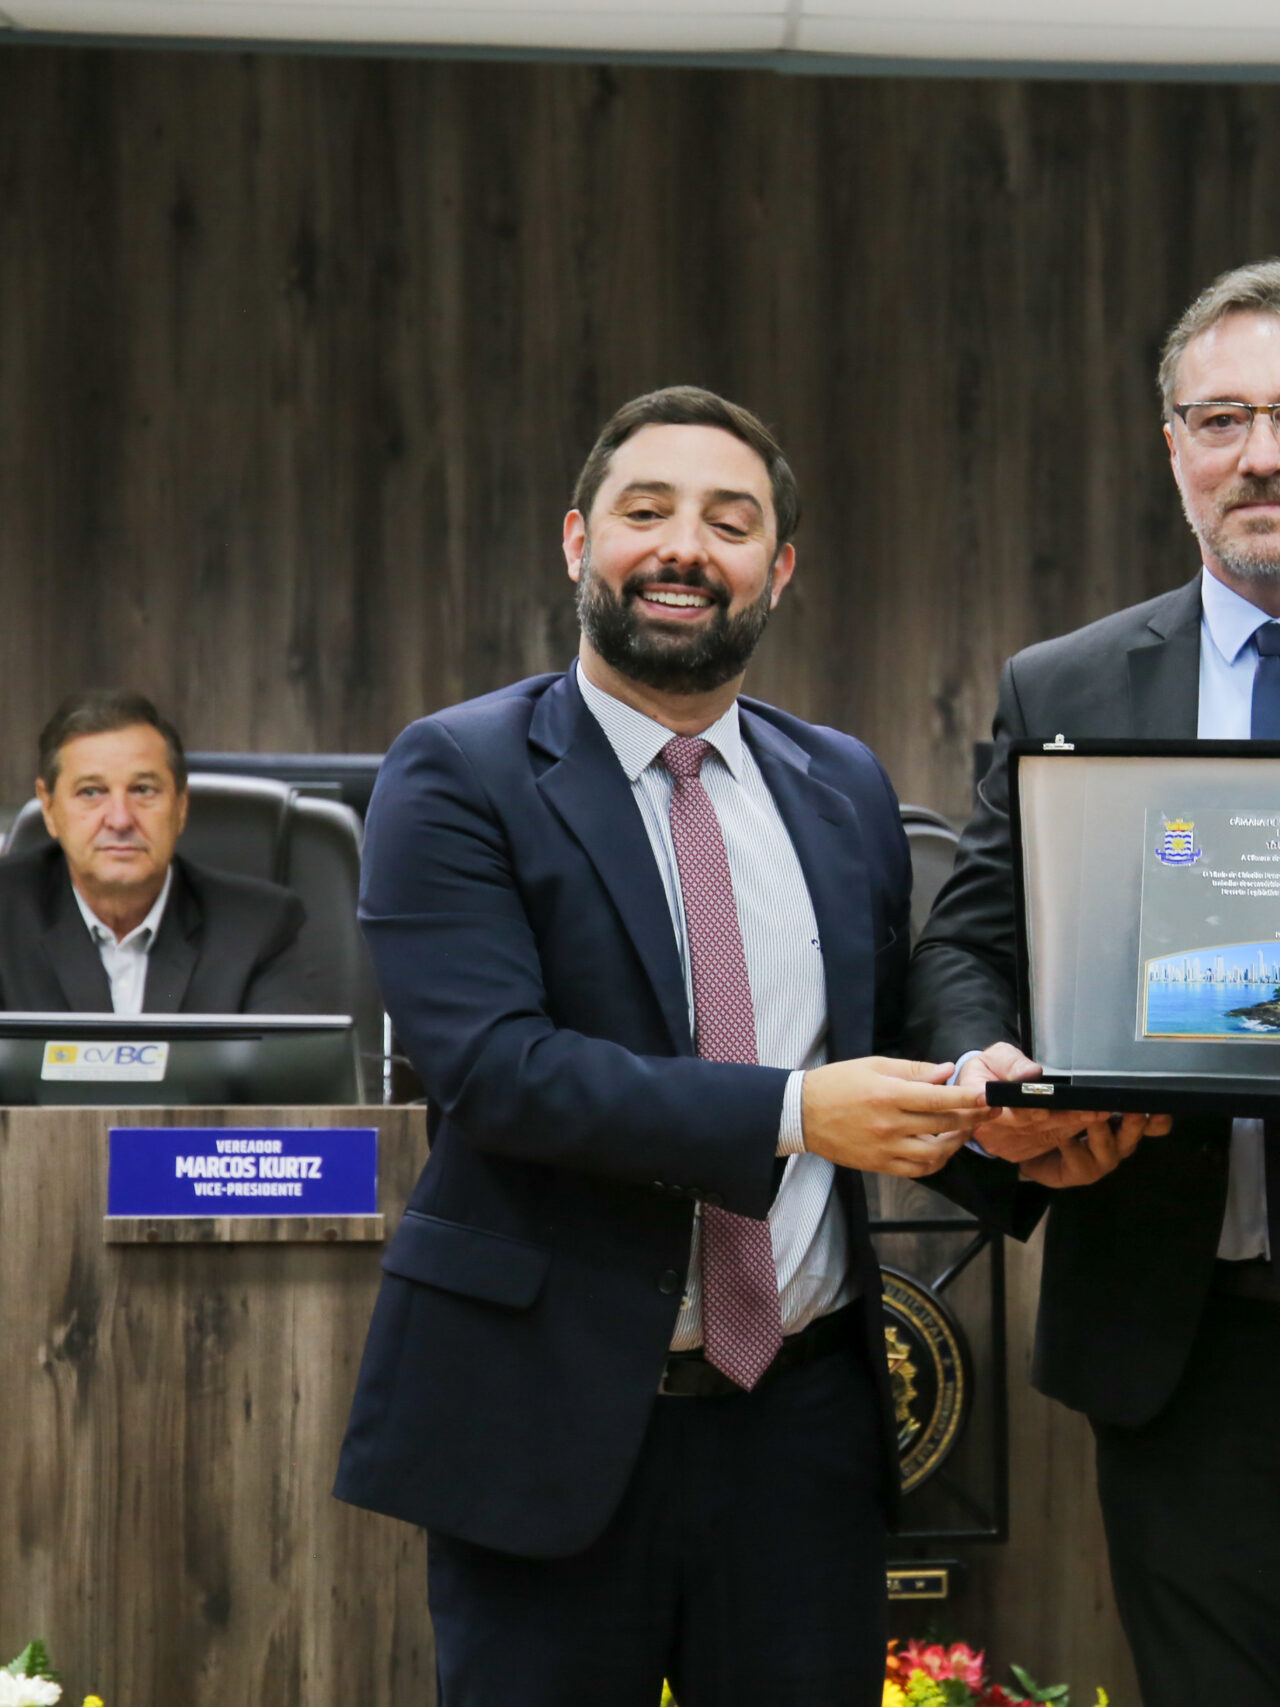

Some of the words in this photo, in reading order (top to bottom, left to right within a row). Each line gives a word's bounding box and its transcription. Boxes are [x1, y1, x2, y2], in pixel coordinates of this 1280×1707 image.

[216, 1139, 282, 1154] VEREADOR
[175, 1155, 257, 1179] MARCOS
[258, 1156, 322, 1179] KURTZ
[193, 1182, 303, 1197] VICE-PRESIDENTE
